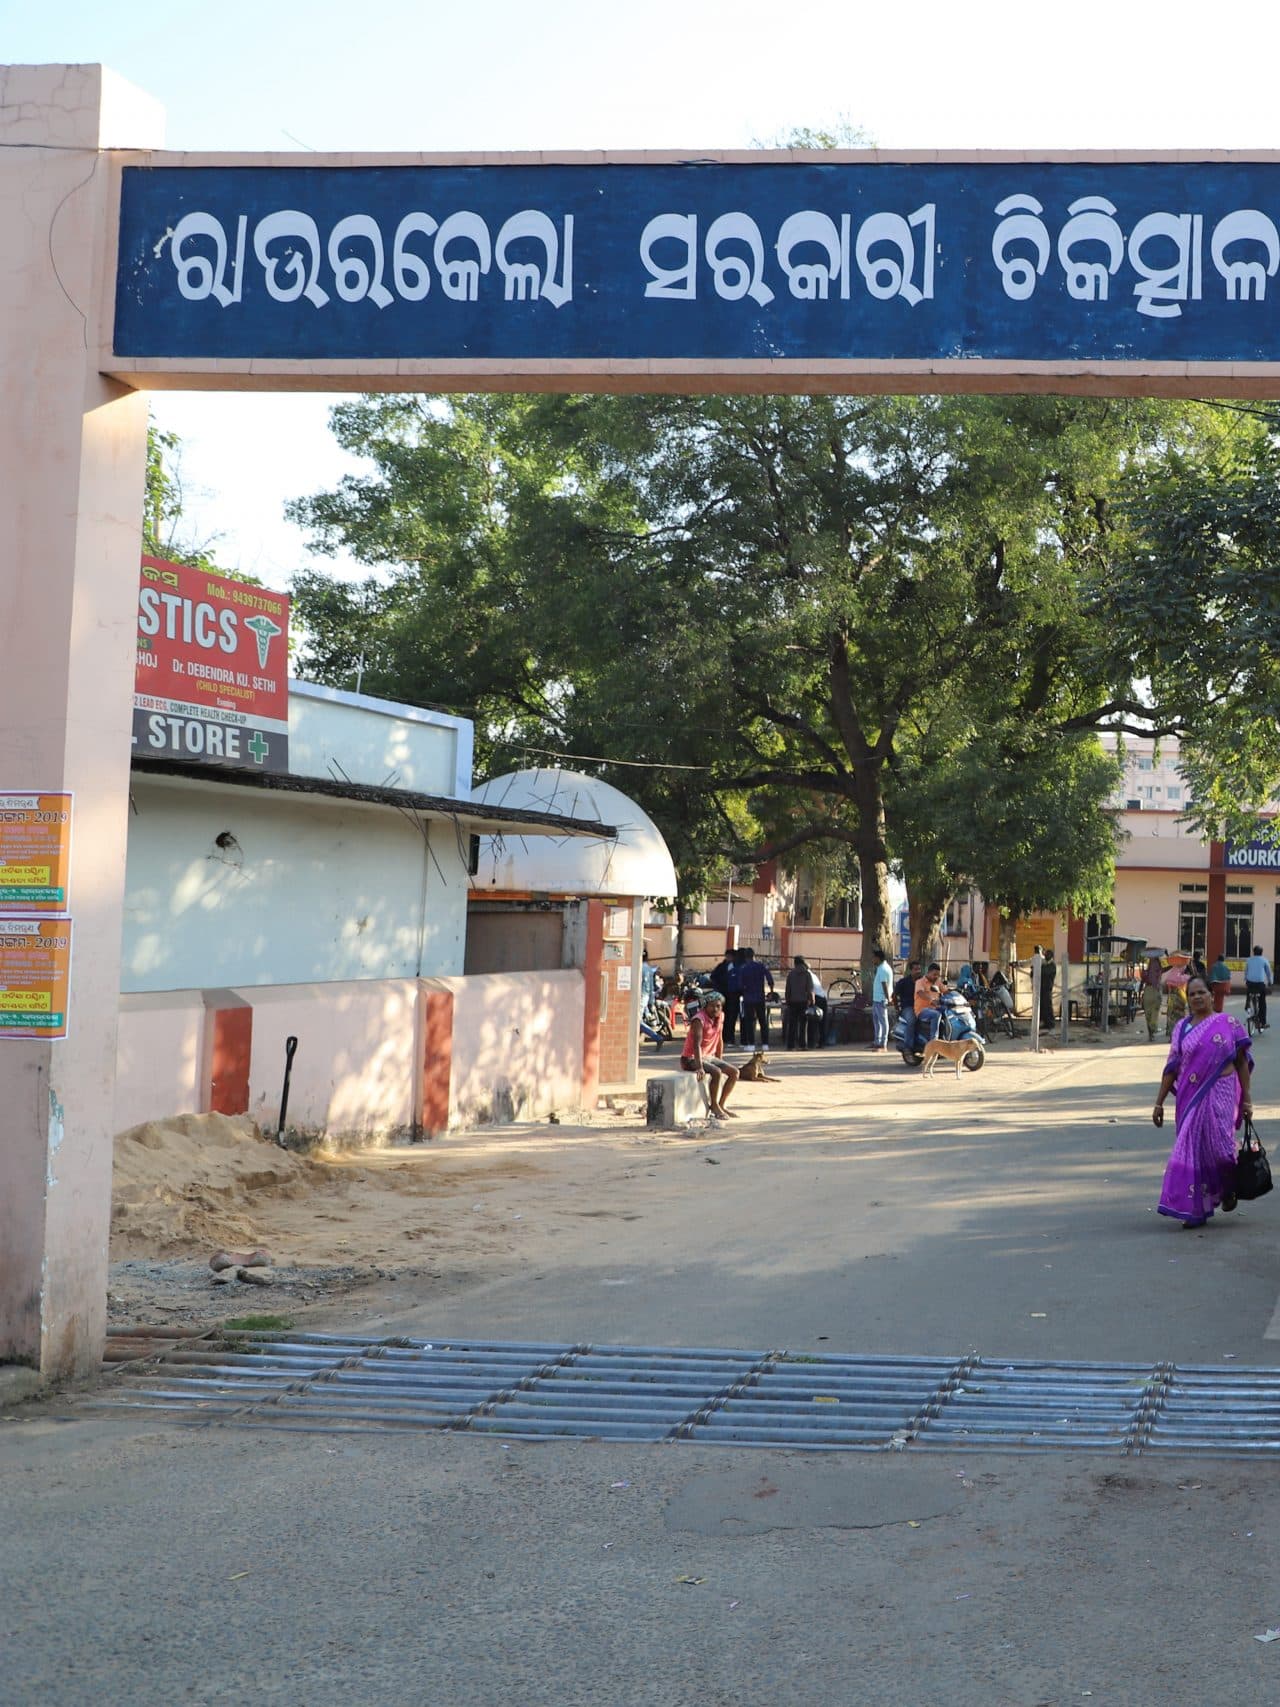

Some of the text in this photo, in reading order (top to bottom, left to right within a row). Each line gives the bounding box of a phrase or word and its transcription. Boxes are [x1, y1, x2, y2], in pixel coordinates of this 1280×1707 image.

[173, 210, 574, 308] ରାଉରକେଲା
[639, 203, 935, 308] ସରକାରୀ
[139, 588, 238, 654] STICS
[172, 659, 185, 674] Dr.
[187, 661, 235, 684] DEBENDRA
[237, 672, 251, 688] KU.
[252, 676, 276, 693] SETHI
[170, 702, 199, 717] COMPLETE
[201, 707, 220, 721] HEALTH
[148, 714, 241, 758] STORE
[34, 811, 67, 823] 2019
[35, 937, 67, 948] 2019
